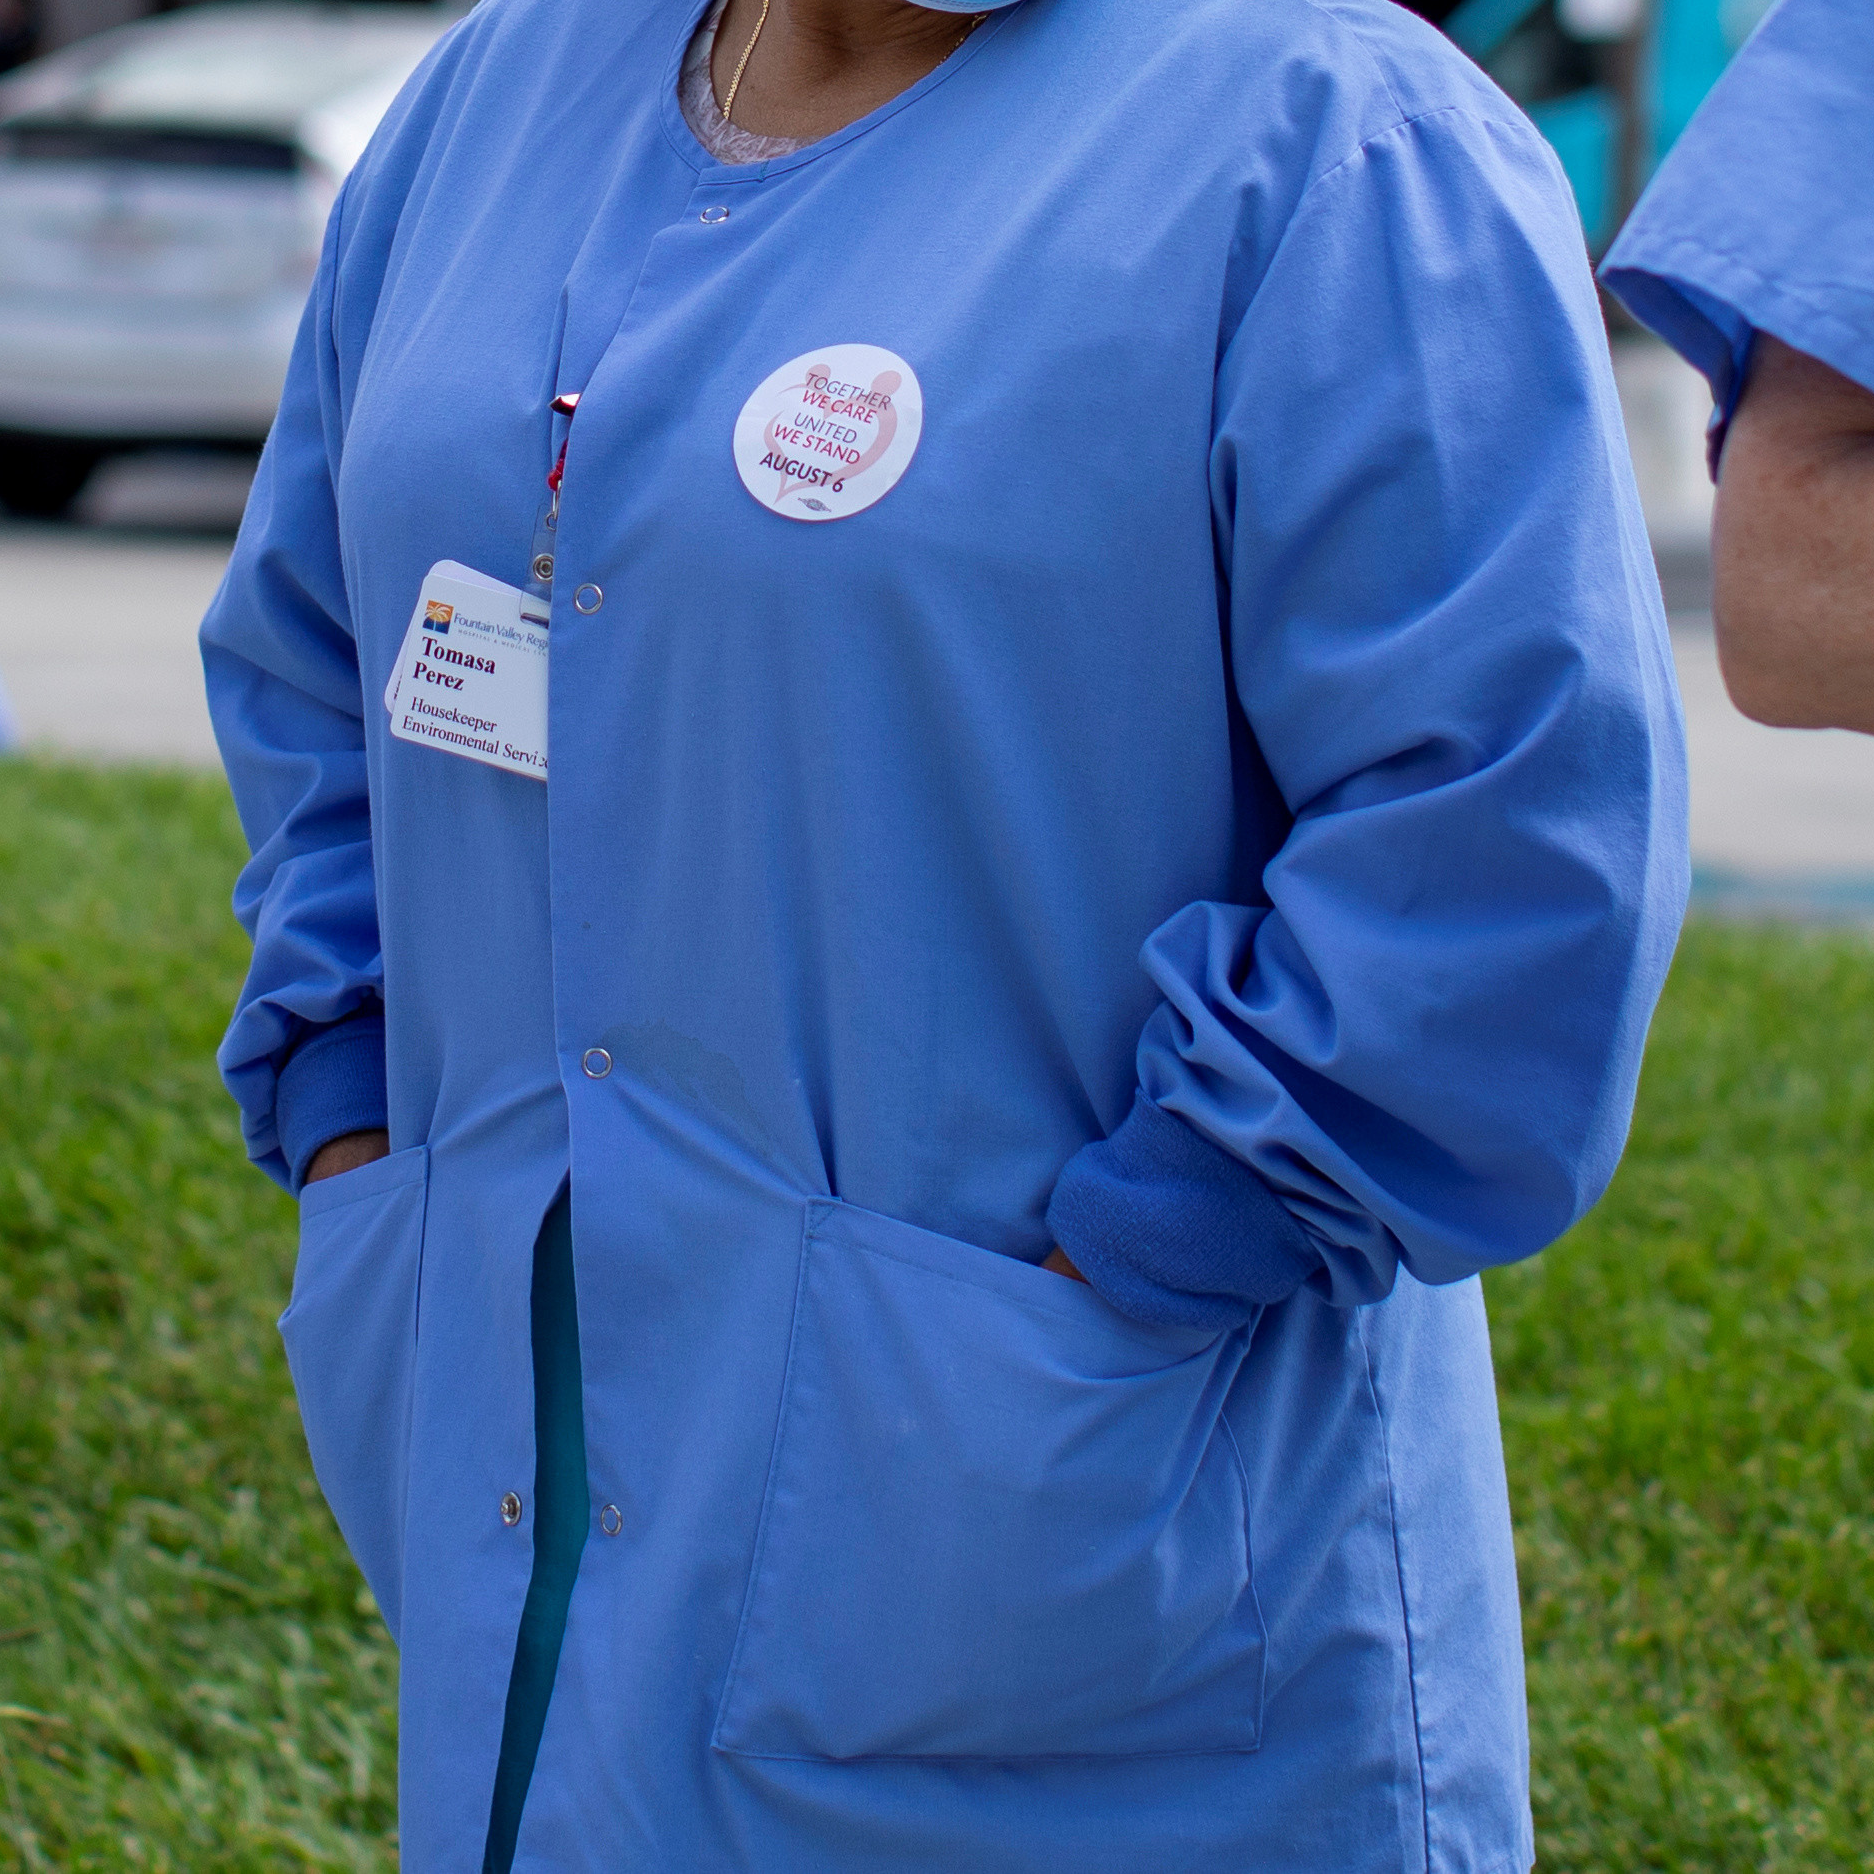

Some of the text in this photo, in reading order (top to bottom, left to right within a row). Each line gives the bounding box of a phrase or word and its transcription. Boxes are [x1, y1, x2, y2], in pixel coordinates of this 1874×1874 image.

[802, 390, 878, 425] WE CARE
[805, 372, 892, 411] TOGETHER
[774, 423, 862, 466] WE STAND
[794, 412, 858, 444] UNITED
[759, 451, 846, 493] AUGUST 6
[454, 612, 496, 634] Fountain
[497, 623, 525, 647] Valley
[421, 636, 496, 675] Tomasa
[412, 660, 465, 692] Perez
[411, 696, 498, 733] Housekeeper
[402, 714, 500, 756] Environmental
